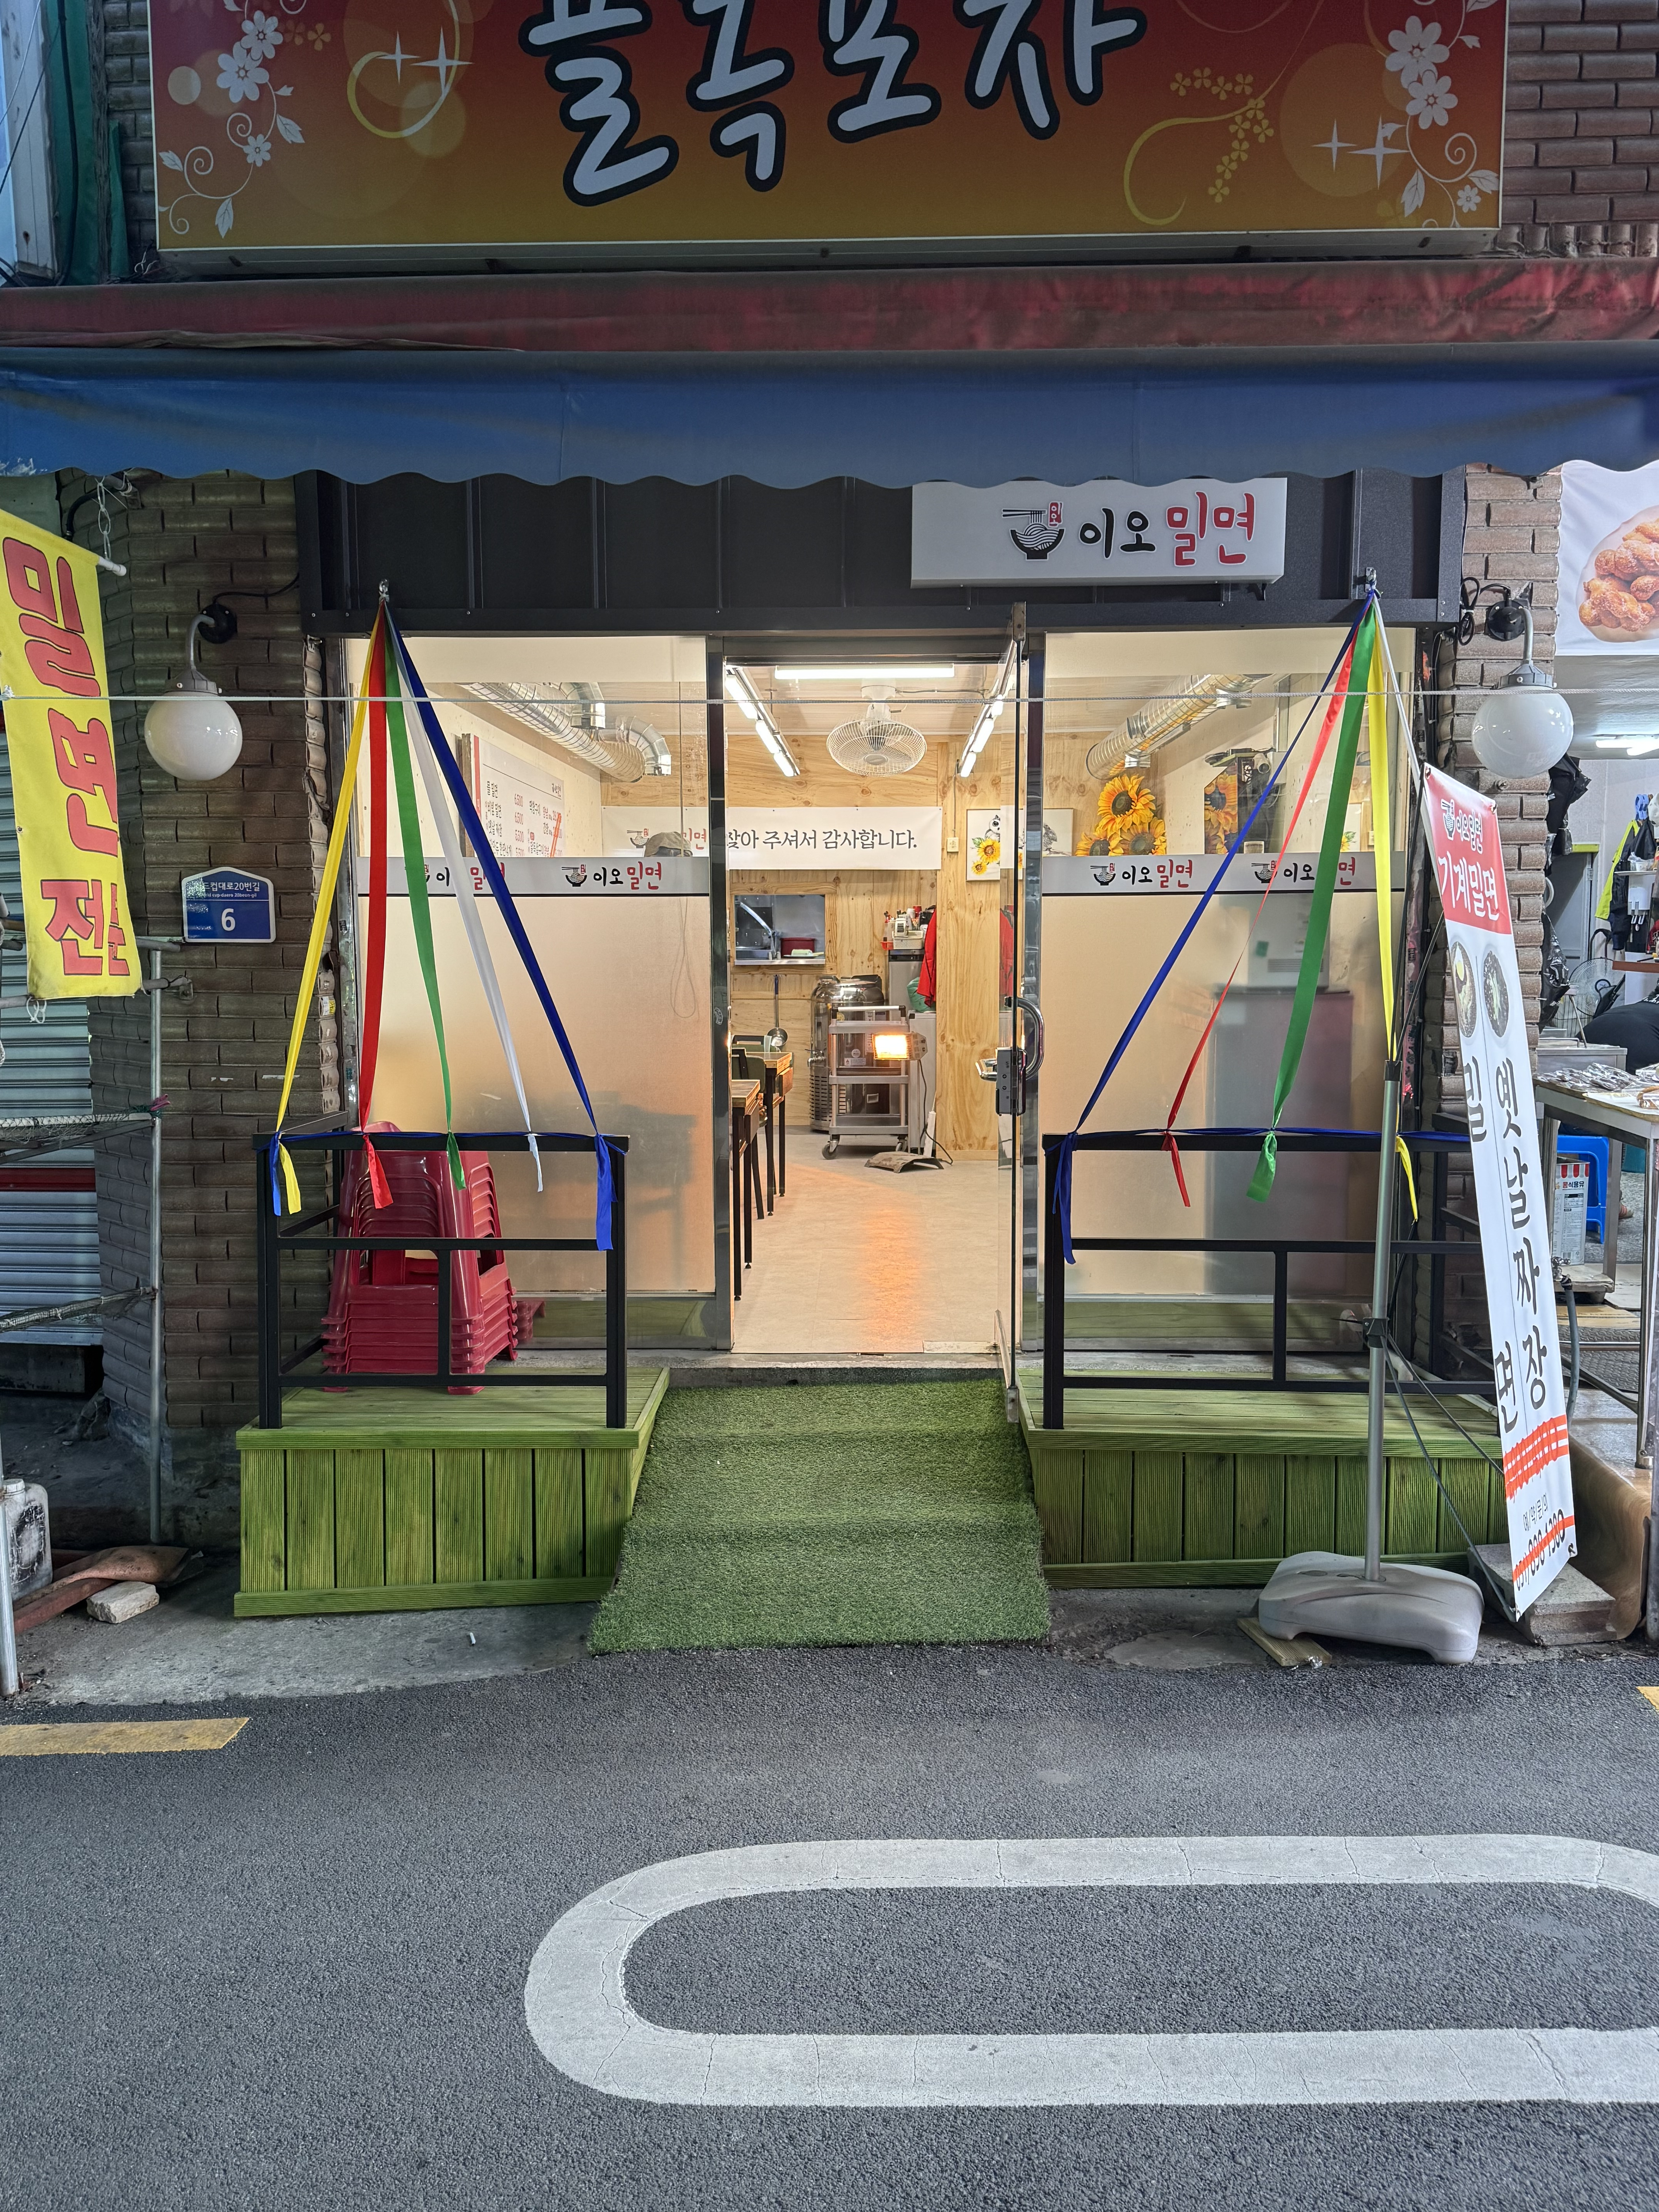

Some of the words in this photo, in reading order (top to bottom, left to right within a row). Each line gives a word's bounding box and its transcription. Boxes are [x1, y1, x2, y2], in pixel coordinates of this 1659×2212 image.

[763, 830, 816, 849] 주셔서
[823, 829, 917, 849] 감사합니다.
[1283, 857, 1355, 886] 이오면
[201, 882, 260, 891] 드컵대로20번길
[1438, 850, 1500, 921] 기계밀면
[221, 908, 235, 931] 6
